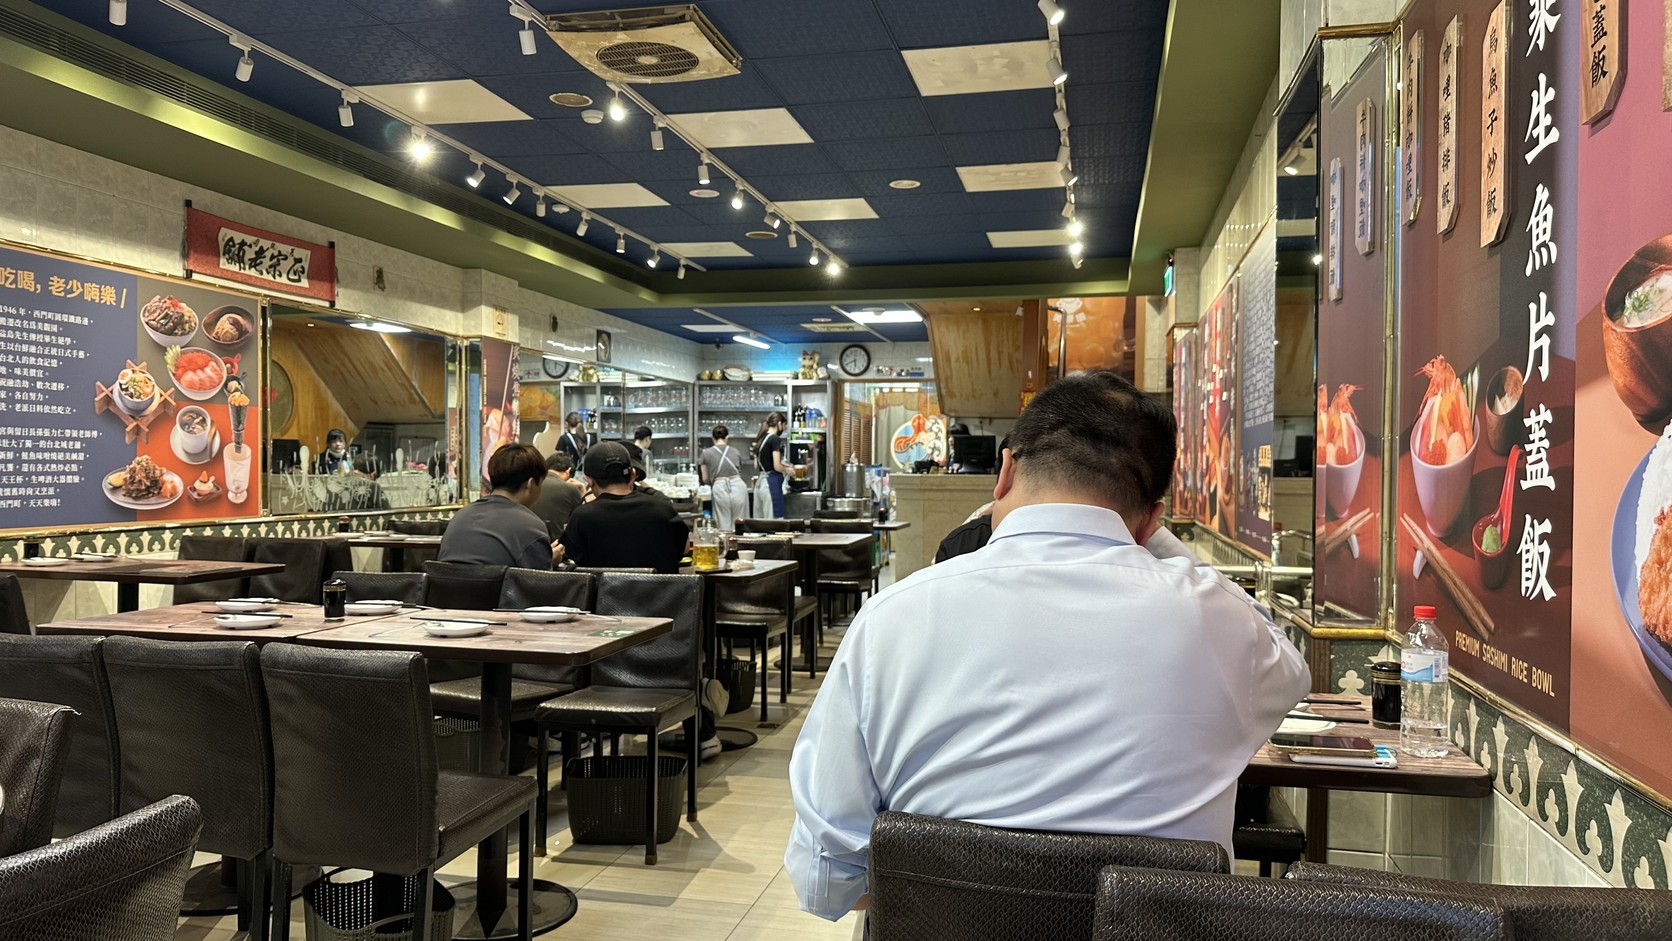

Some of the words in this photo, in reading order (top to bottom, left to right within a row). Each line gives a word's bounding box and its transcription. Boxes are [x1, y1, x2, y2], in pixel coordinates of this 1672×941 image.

[1590, 0, 1608, 88] 蓋飯
[1486, 26, 1499, 219] 烏魚子炒飯
[1455, 630, 1480, 658] PREMIUM
[1482, 643, 1508, 673] SASHIMI
[1511, 656, 1528, 683] RICE
[1531, 666, 1555, 697] BOWL
